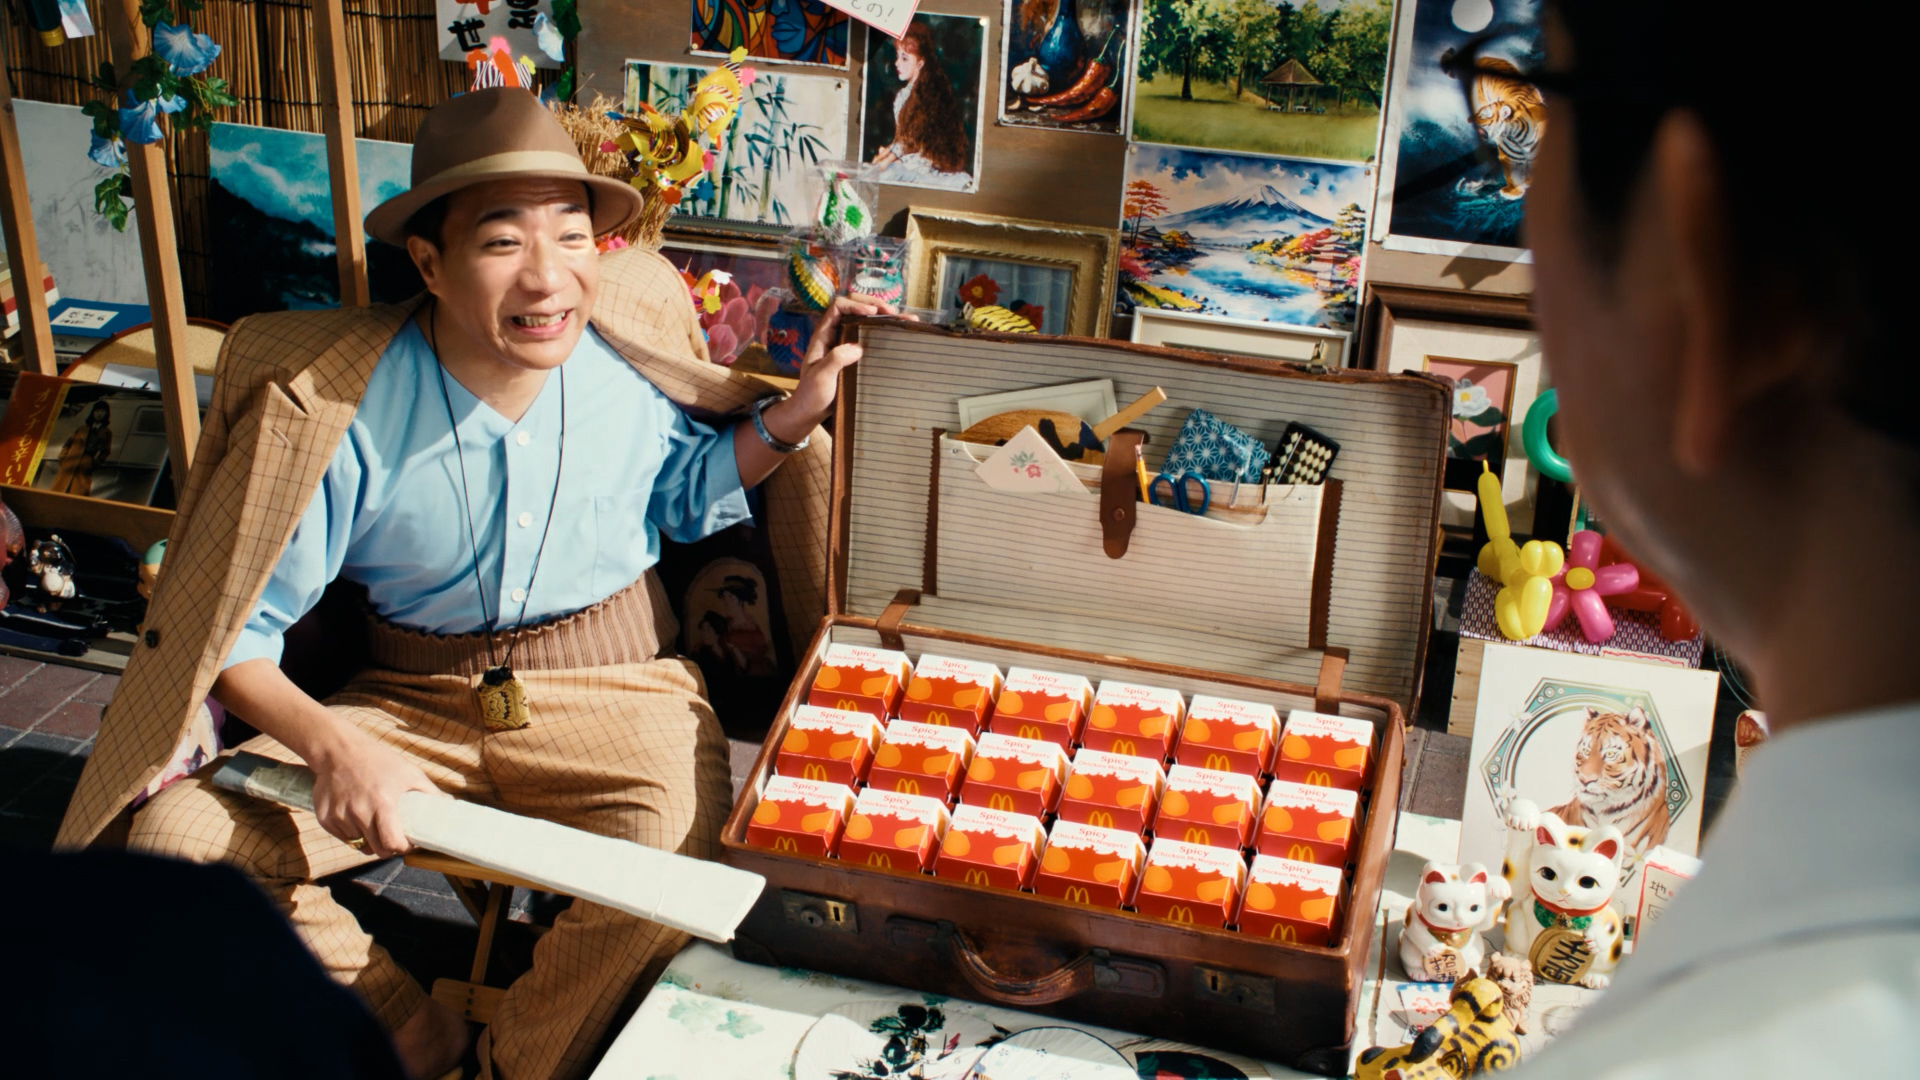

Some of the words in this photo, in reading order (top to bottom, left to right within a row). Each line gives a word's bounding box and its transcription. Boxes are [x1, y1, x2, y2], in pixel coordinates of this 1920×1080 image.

[851, 649, 877, 658] Spicy
[857, 657, 895, 666] McNuggets
[942, 660, 969, 669] Spicy
[949, 669, 986, 678] McNuggets
[1032, 673, 1059, 683] Spicy
[1038, 682, 1077, 691] McNuggets
[1123, 687, 1151, 696] Spicy
[1131, 696, 1171, 705] McNuggets
[1217, 701, 1245, 711] Spicy
[820, 711, 847, 720] Spicy
[1224, 710, 1264, 720] McNuggets
[826, 719, 864, 728] McNuggets
[1315, 717, 1345, 727] Spicy
[912, 726, 939, 735] Spicy
[1293, 722, 1321, 730] Chicken
[1323, 726, 1364, 736] McNuggets
[918, 734, 956, 744] McNuggets
[1004, 739, 1032, 749] Spicy
[1010, 748, 1050, 758] McNuggets
[1100, 755, 1129, 765] Spicy
[1077, 760, 1106, 768] Chicken
[1107, 765, 1149, 775] McNuggets
[1195, 771, 1224, 782] Spicy
[792, 781, 820, 791] Spicy
[1172, 777, 1201, 785] Chicken
[1203, 781, 1245, 791] McNuggets
[798, 791, 836, 800] McNuggets
[1298, 787, 1328, 797] Spicy
[883, 795, 912, 805] Spicy
[1274, 792, 1304, 800] Chicken
[1305, 797, 1349, 808] McNuggets
[860, 800, 888, 808] Chicken
[889, 804, 929, 814] McNuggets
[979, 812, 1008, 822] Spicy
[956, 817, 985, 825] Chicken
[986, 821, 1027, 832] McNuggets
[1079, 827, 1108, 838] Spicy
[1055, 832, 1084, 841] Chicken
[1086, 837, 1128, 848] McNuggets
[1180, 846, 1209, 857] Spicy
[1155, 851, 1185, 859] Chicken
[1187, 856, 1230, 867] McNuggets
[1281, 863, 1313, 874] Spicy
[1257, 867, 1287, 876] Chicken
[1289, 872, 1333, 885] McNuggets
